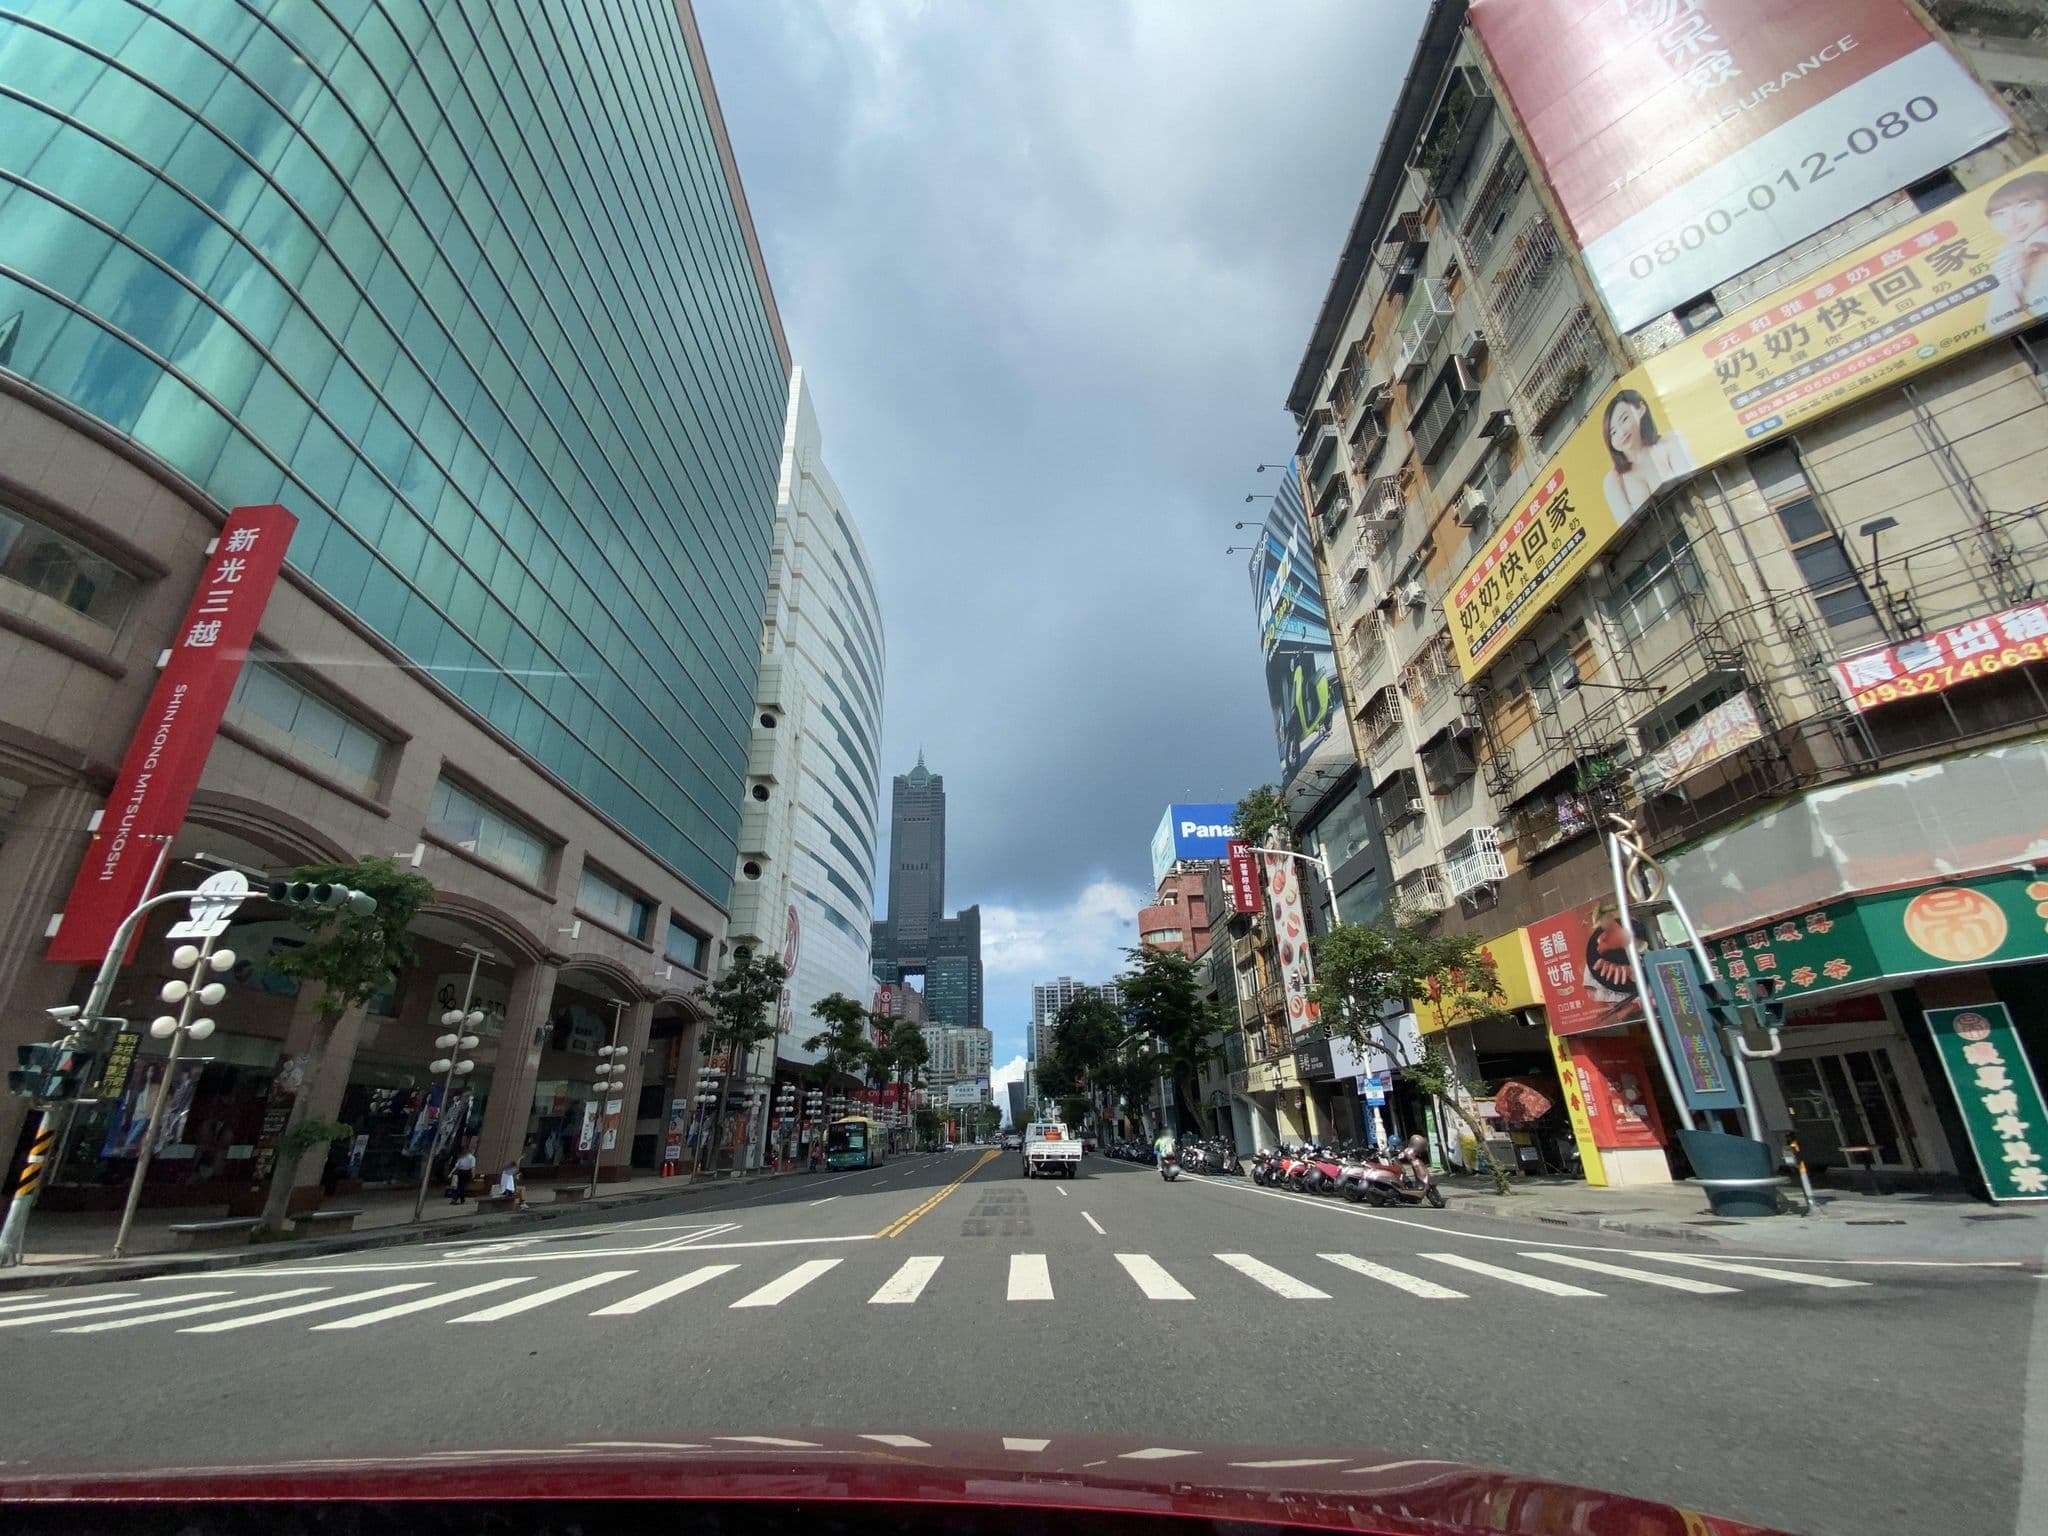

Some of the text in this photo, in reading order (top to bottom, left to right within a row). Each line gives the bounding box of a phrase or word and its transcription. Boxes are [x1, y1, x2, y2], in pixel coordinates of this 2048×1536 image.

[1630, 95, 1939, 281] 0800-012-080
[1713, 238, 1980, 385] 奶奶快回家
[184, 527, 261, 647] 新光三越
[1460, 488, 1576, 634] 奶奶快回家
[100, 684, 188, 881] SHIN KONG MITSUKOSHI
[1540, 930, 1568, 958] 香腸
[1547, 962, 1576, 987] 世家
